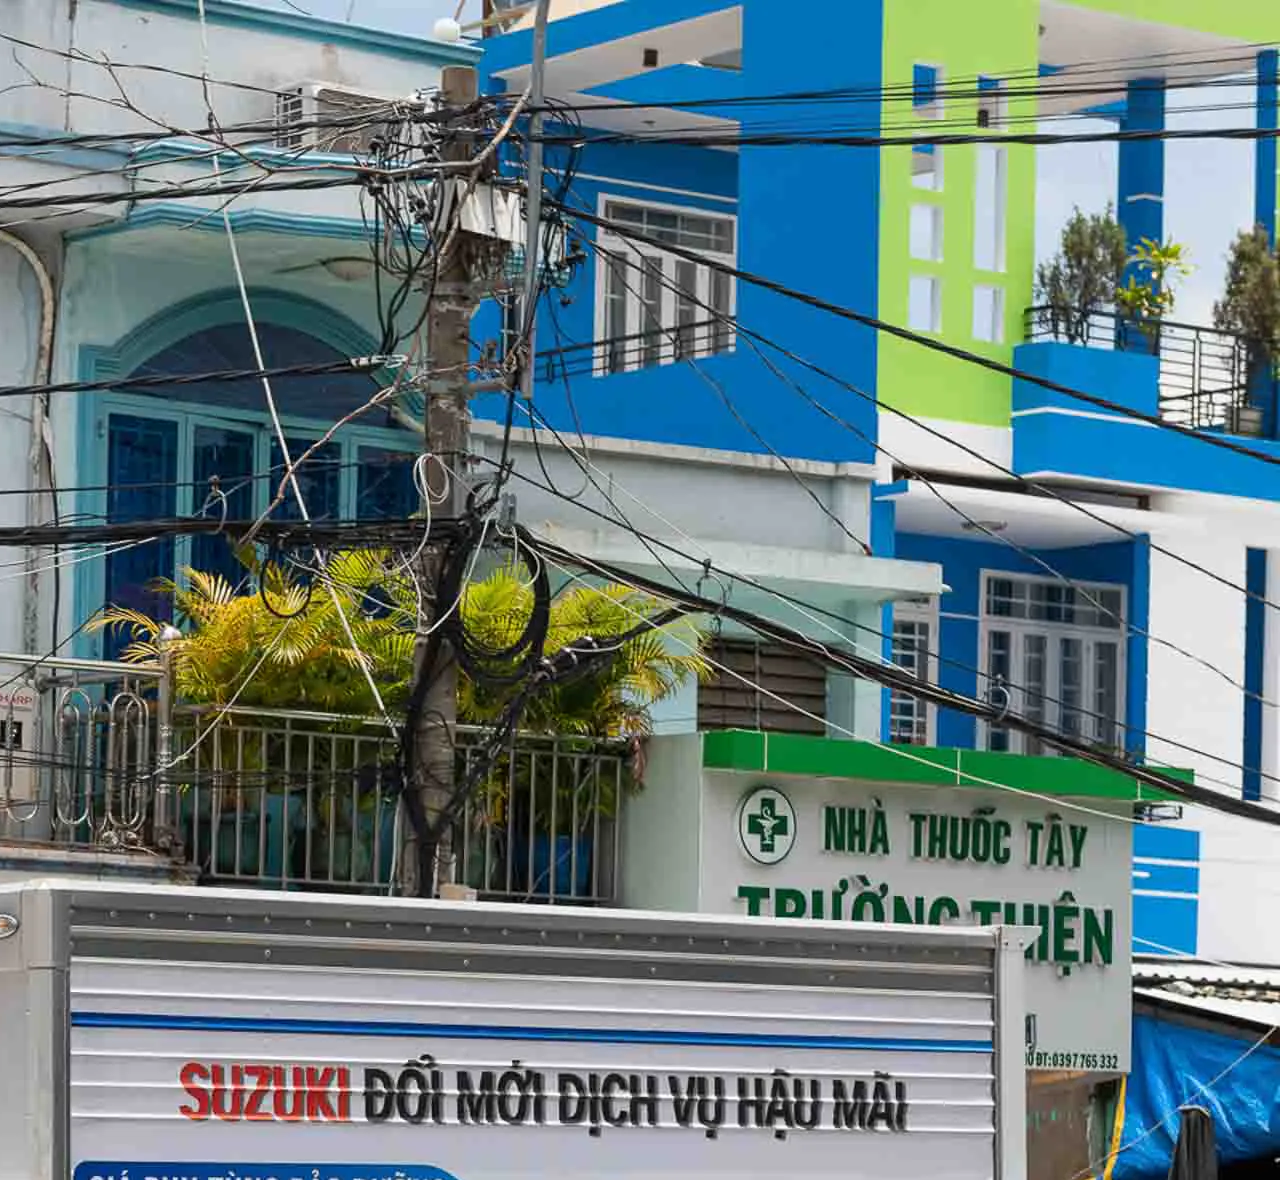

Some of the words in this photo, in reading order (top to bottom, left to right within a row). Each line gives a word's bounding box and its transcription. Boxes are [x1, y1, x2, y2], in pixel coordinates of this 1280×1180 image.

[823, 798, 890, 856] NHÀ
[908, 807, 1011, 866] THUỐC
[1025, 813, 1088, 870] TÂY
[1080, 1053, 1098, 1069] 765
[1100, 1054, 1119, 1069] 332
[178, 1062, 352, 1124] SUZUKI
[363, 1054, 447, 1126] ĐỔI
[456, 1059, 548, 1127] MỚI
[557, 1072, 659, 1137] DỊCH
[667, 1075, 725, 1139] VỤ
[736, 1068, 820, 1141] HẬU
[832, 1070, 909, 1132] MÃI
